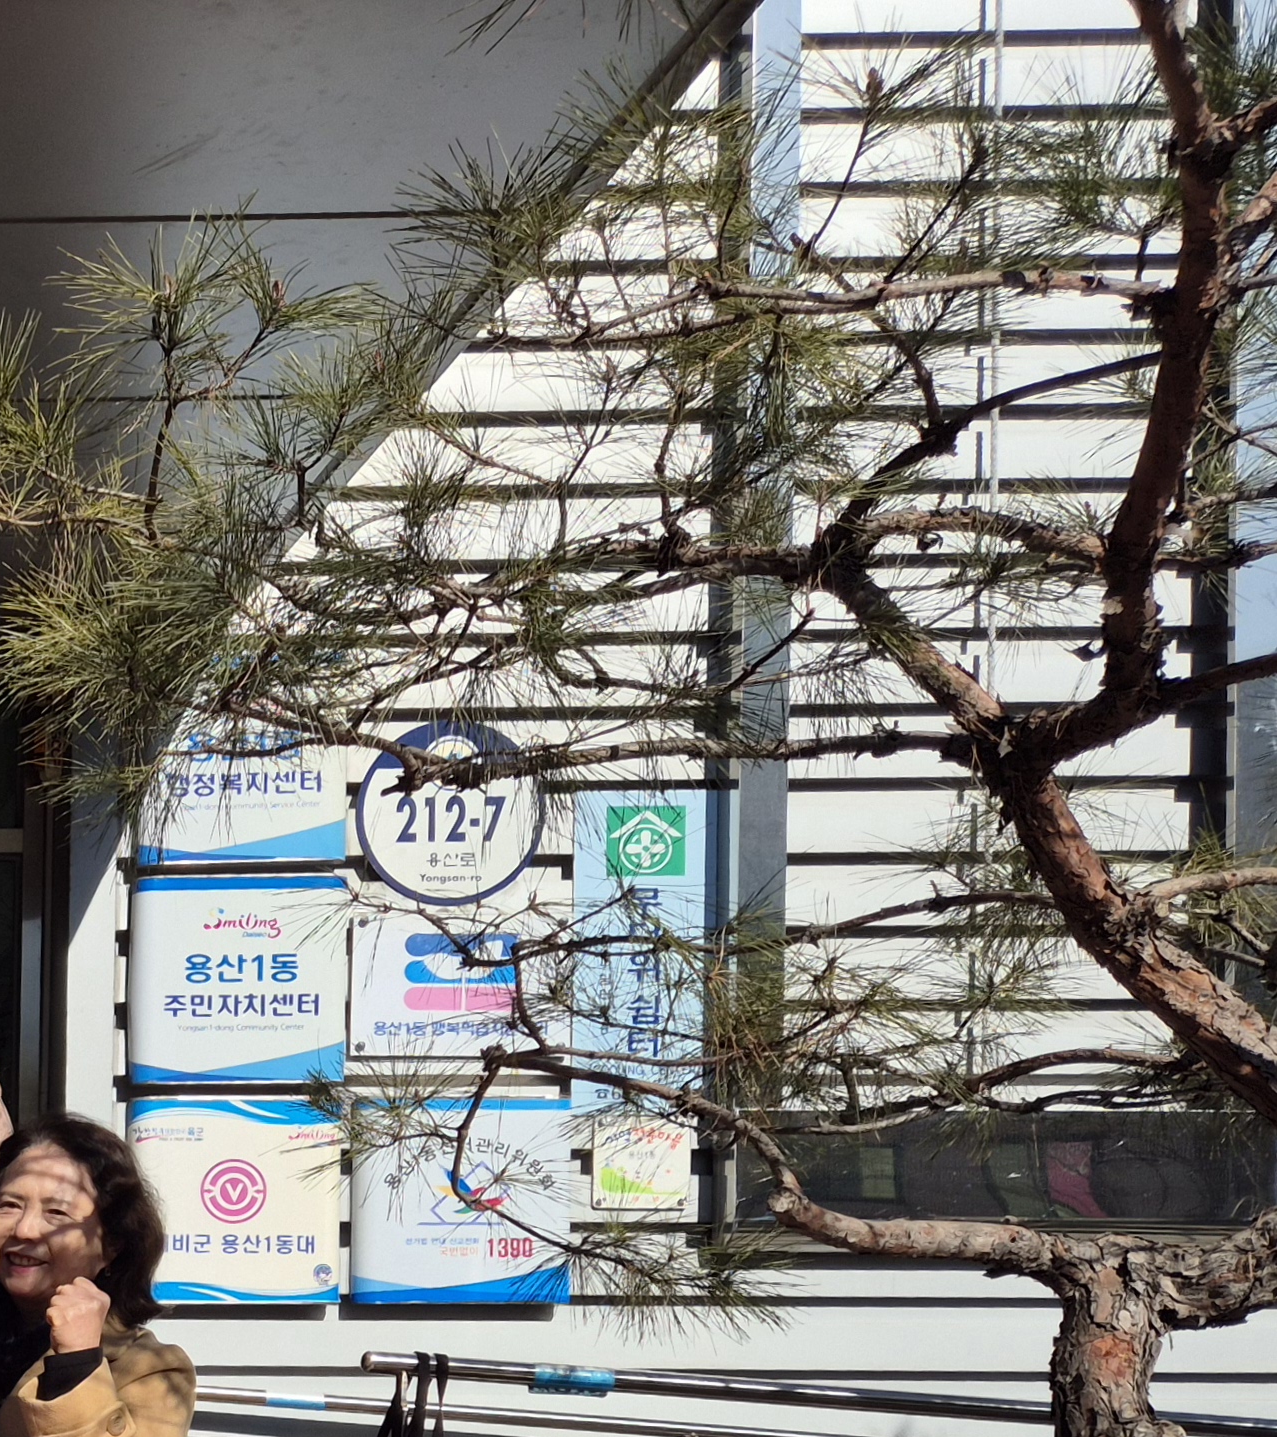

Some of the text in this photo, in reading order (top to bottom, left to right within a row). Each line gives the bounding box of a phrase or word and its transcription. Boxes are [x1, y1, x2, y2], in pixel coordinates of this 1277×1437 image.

[396, 796, 507, 843] 212-7
[427, 852, 476, 868] 용산로
[419, 873, 483, 885] Yongsan-ro
[203, 907, 282, 939] Smiling
[185, 953, 299, 984] 용산1동
[163, 993, 320, 1018] 주민자치센터
[280, 1023, 305, 1032] Center
[373, 1021, 427, 1036] 용산1동
[164, 1233, 316, 1255] 비군 용산1동대
[487, 1237, 534, 1259] 1390
